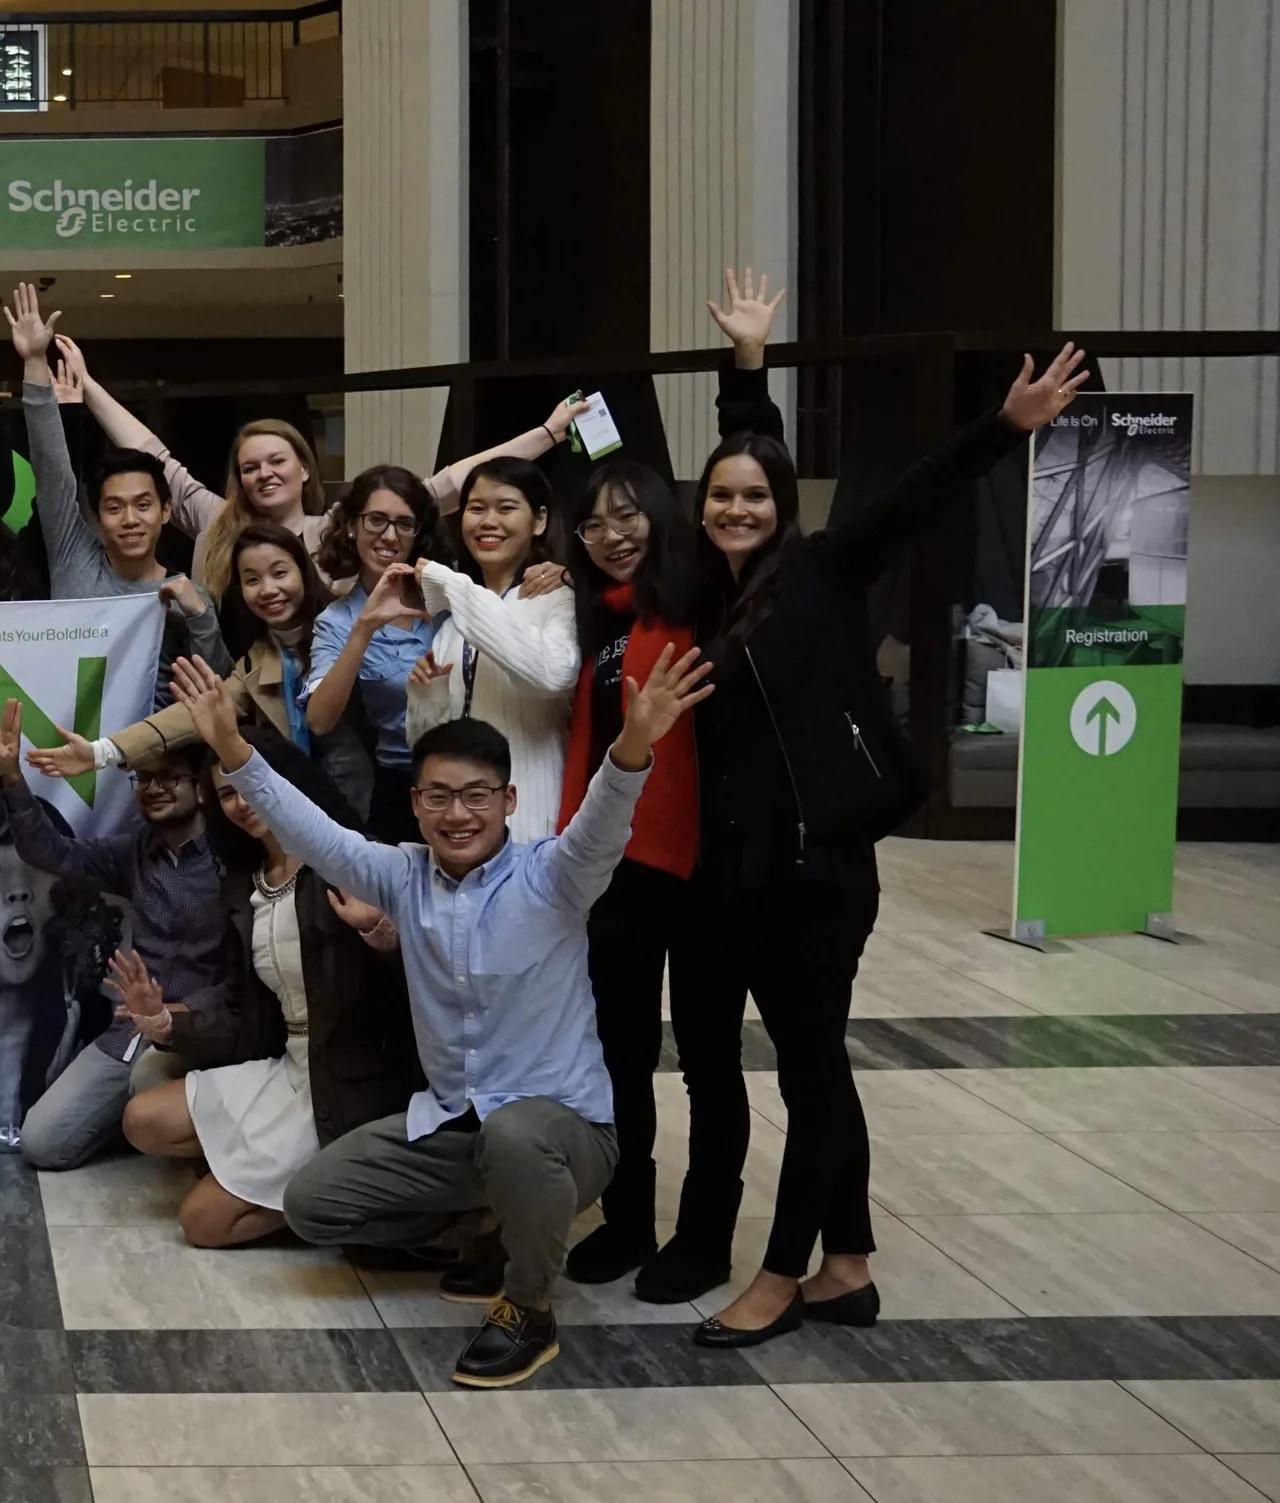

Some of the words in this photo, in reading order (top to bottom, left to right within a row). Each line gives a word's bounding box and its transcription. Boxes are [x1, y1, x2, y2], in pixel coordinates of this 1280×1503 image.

[8, 179, 201, 212] Schneider
[91, 213, 196, 233] Electric
[1111, 412, 1177, 427] Schneider
[1139, 426, 1176, 435] Electric
[1065, 628, 1149, 647] Registration
